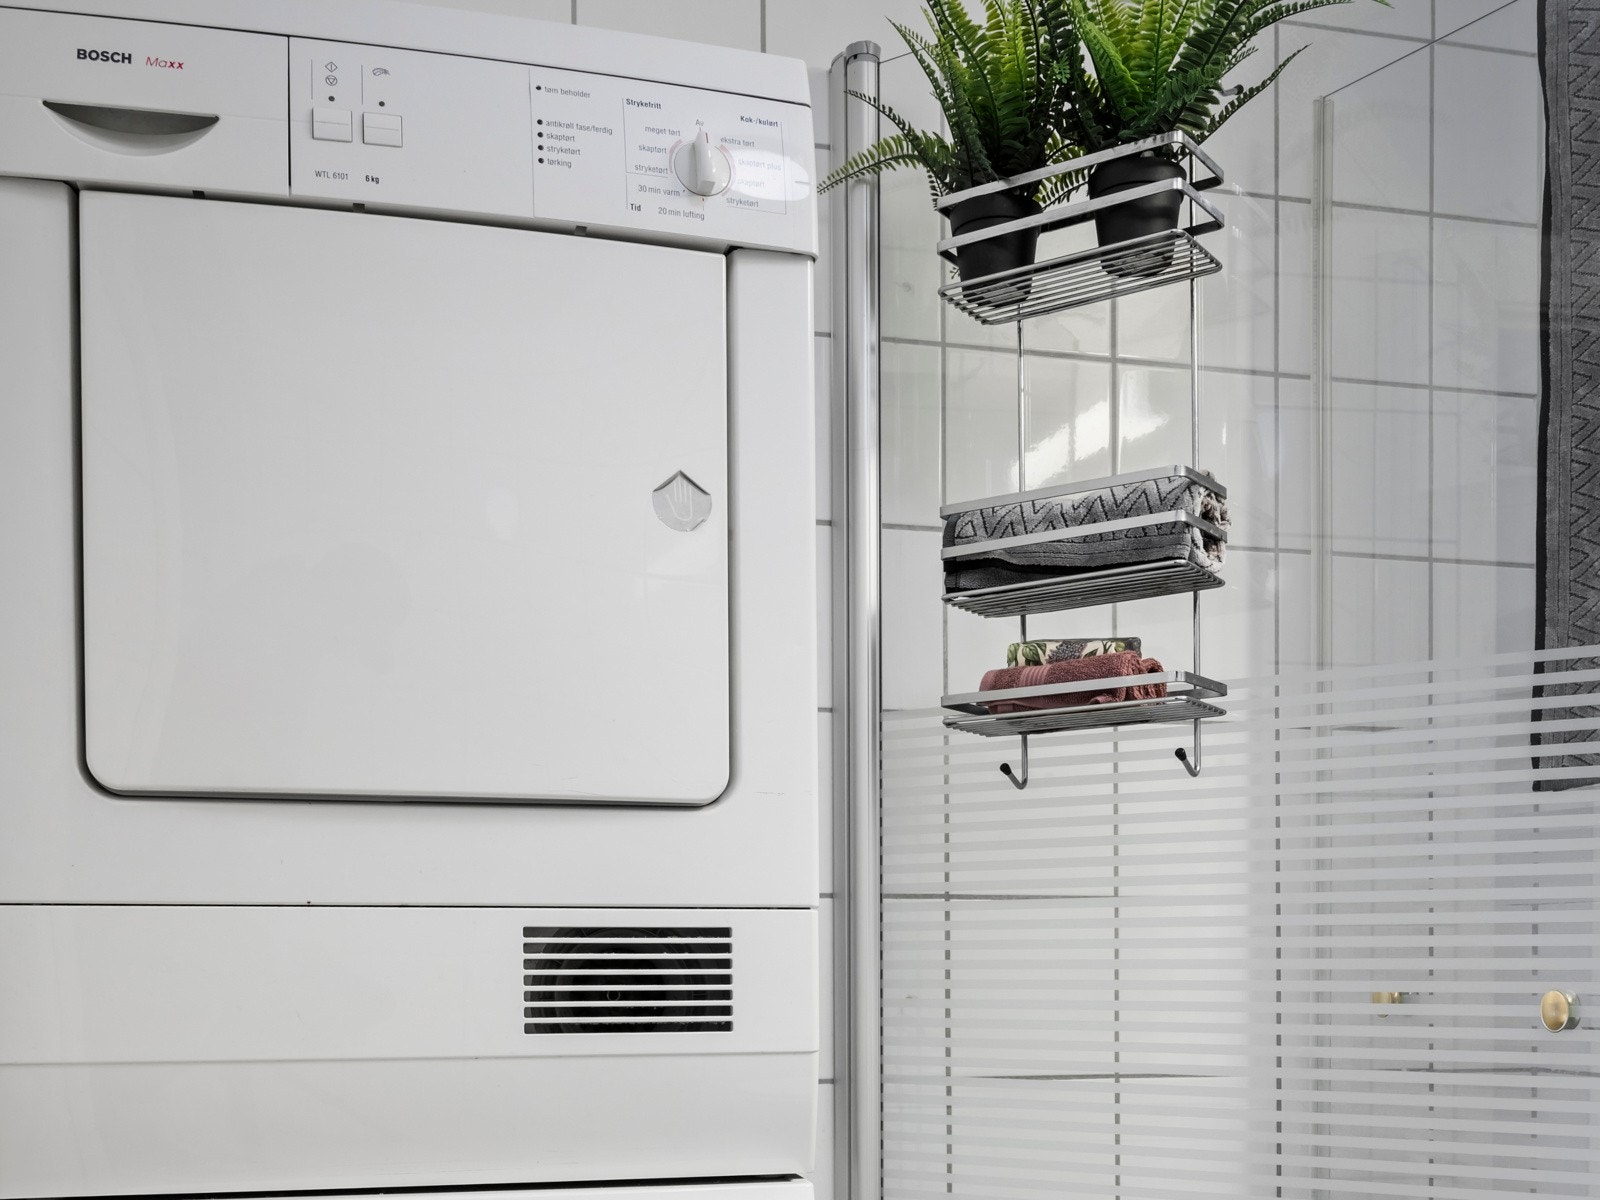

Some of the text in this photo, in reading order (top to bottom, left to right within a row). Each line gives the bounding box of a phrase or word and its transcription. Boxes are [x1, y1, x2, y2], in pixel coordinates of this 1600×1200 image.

[77, 48, 184, 70] BOSCH Maxx
[560, 88, 590, 98] beholder
[626, 98, 662, 110] Strykefritt
[546, 120, 574, 129] antikrøll
[696, 118, 704, 126] Av
[740, 115, 778, 127] Kok-/kulørt
[644, 126, 680, 136] meget tørt
[546, 132, 575, 142] skaptørt
[720, 136, 755, 148] ekstra tørt
[546, 145, 580, 156] stryketørt
[638, 144, 667, 154] skaptørt
[547, 158, 572, 168] tørking
[634, 164, 668, 174] stryketørt
[314, 170, 348, 180] WTL 6101
[370, 176, 380, 184] kg
[638, 184, 647, 192] 30
[648, 186, 661, 194] min
[630, 203, 642, 212] Tid
[726, 197, 759, 208] stryketørt
[658, 206, 705, 221] 20 min lufting
